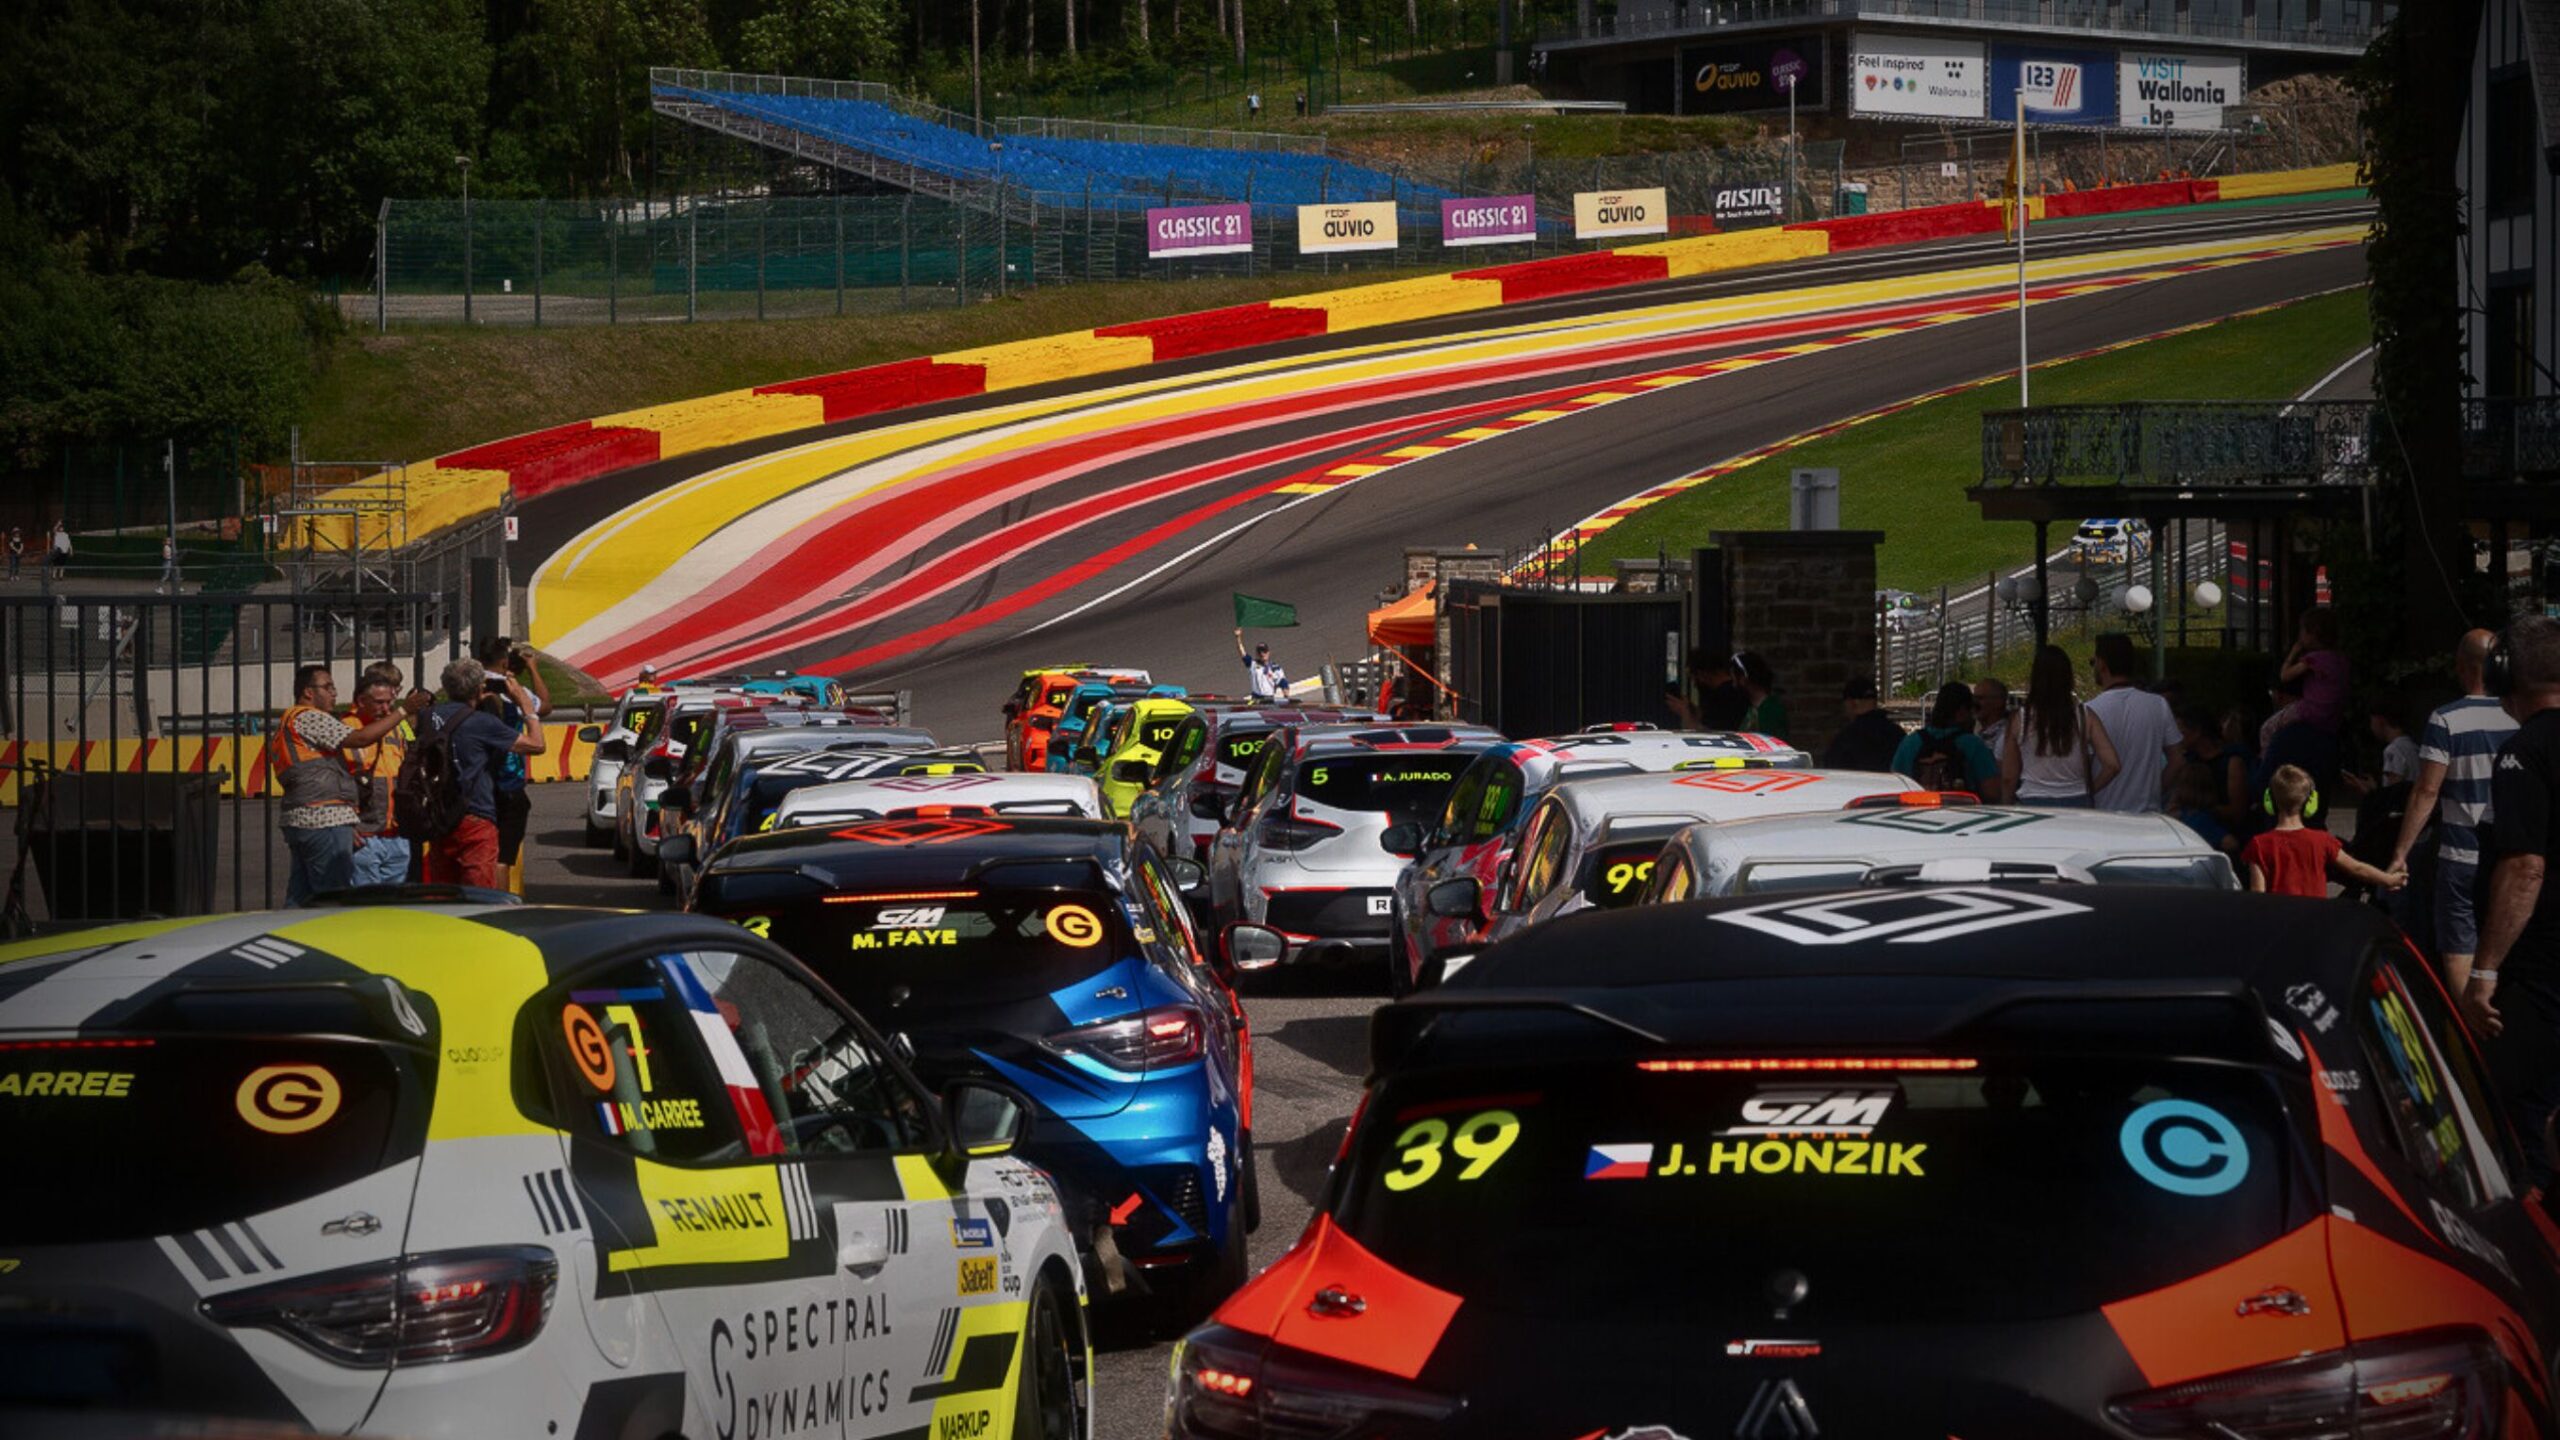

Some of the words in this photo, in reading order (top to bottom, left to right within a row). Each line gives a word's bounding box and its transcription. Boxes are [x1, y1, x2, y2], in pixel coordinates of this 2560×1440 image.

[1857, 55, 1880, 69] Feel
[1883, 57, 1926, 71] inspired
[2138, 57, 2186, 79] VISIT
[2026, 65, 2055, 87] 123
[2138, 80, 2226, 104] Wallonia
[1158, 218, 1220, 239] CLASSIC
[1224, 214, 1243, 236] 21
[1451, 207, 1508, 228] CLASSIC
[1511, 205, 1528, 225] 21
[1152, 728, 1175, 741] 10
[1311, 767, 1329, 785] 5
[1382, 771, 1397, 782] A.
[1400, 771, 1453, 782] JURADO
[851, 931, 882, 950] M.
[888, 929, 958, 947] FAYE
[605, 1004, 653, 1092] 7
[640, 1099, 705, 1129] CARREE
[1384, 1109, 1521, 1191] 39
[1657, 1143, 1697, 1176] J.
[1708, 1140, 1928, 1177] HONZIK
[658, 1192, 773, 1232] RENAULT
[960, 1260, 995, 1294] Sabelt
[743, 1292, 892, 1359] SPECTRAL
[746, 1370, 890, 1440] DYNAMICS
[939, 1410, 990, 1440] MARKUP
